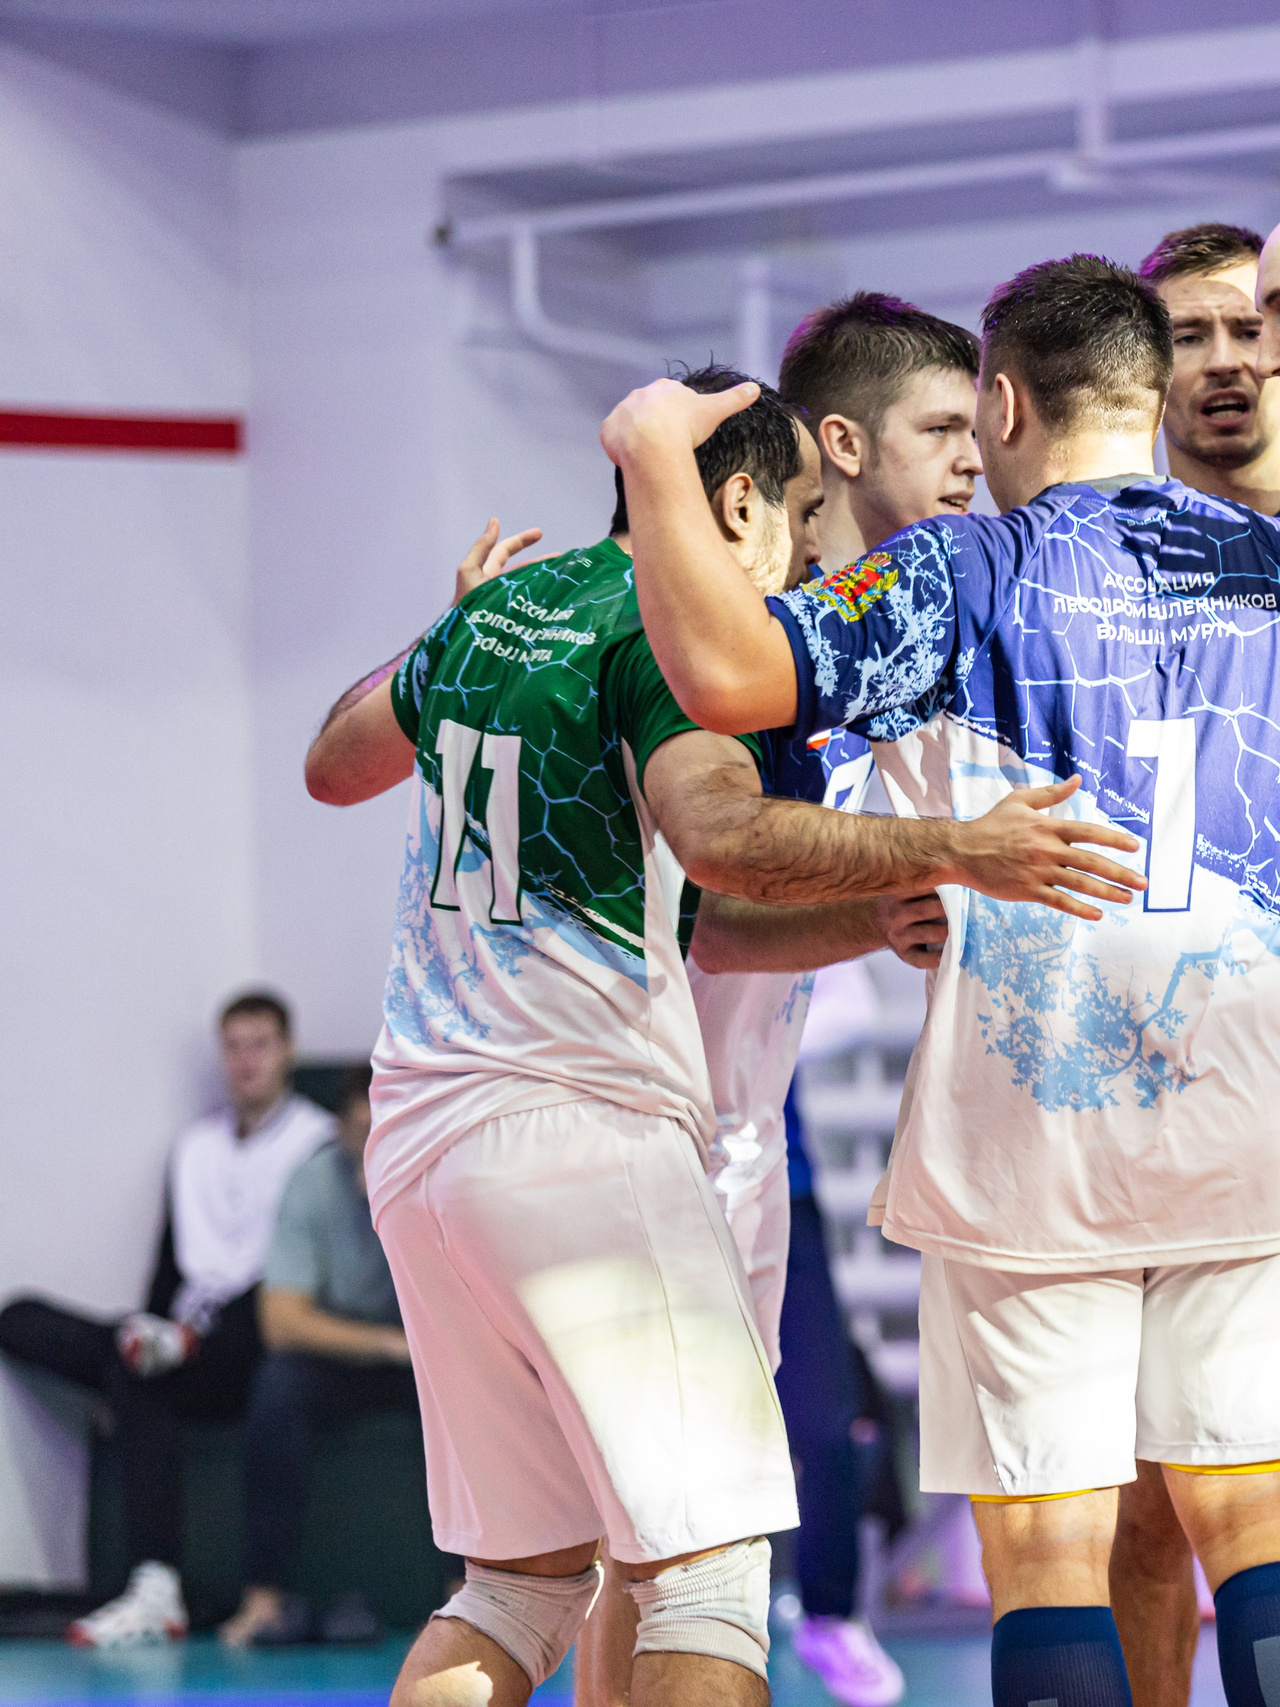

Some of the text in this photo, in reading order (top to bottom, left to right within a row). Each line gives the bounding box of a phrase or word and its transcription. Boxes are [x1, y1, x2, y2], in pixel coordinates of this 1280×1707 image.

[1171, 621, 1236, 644] МУРТА
[430, 718, 523, 926] 11
[1127, 717, 1196, 912] 1
